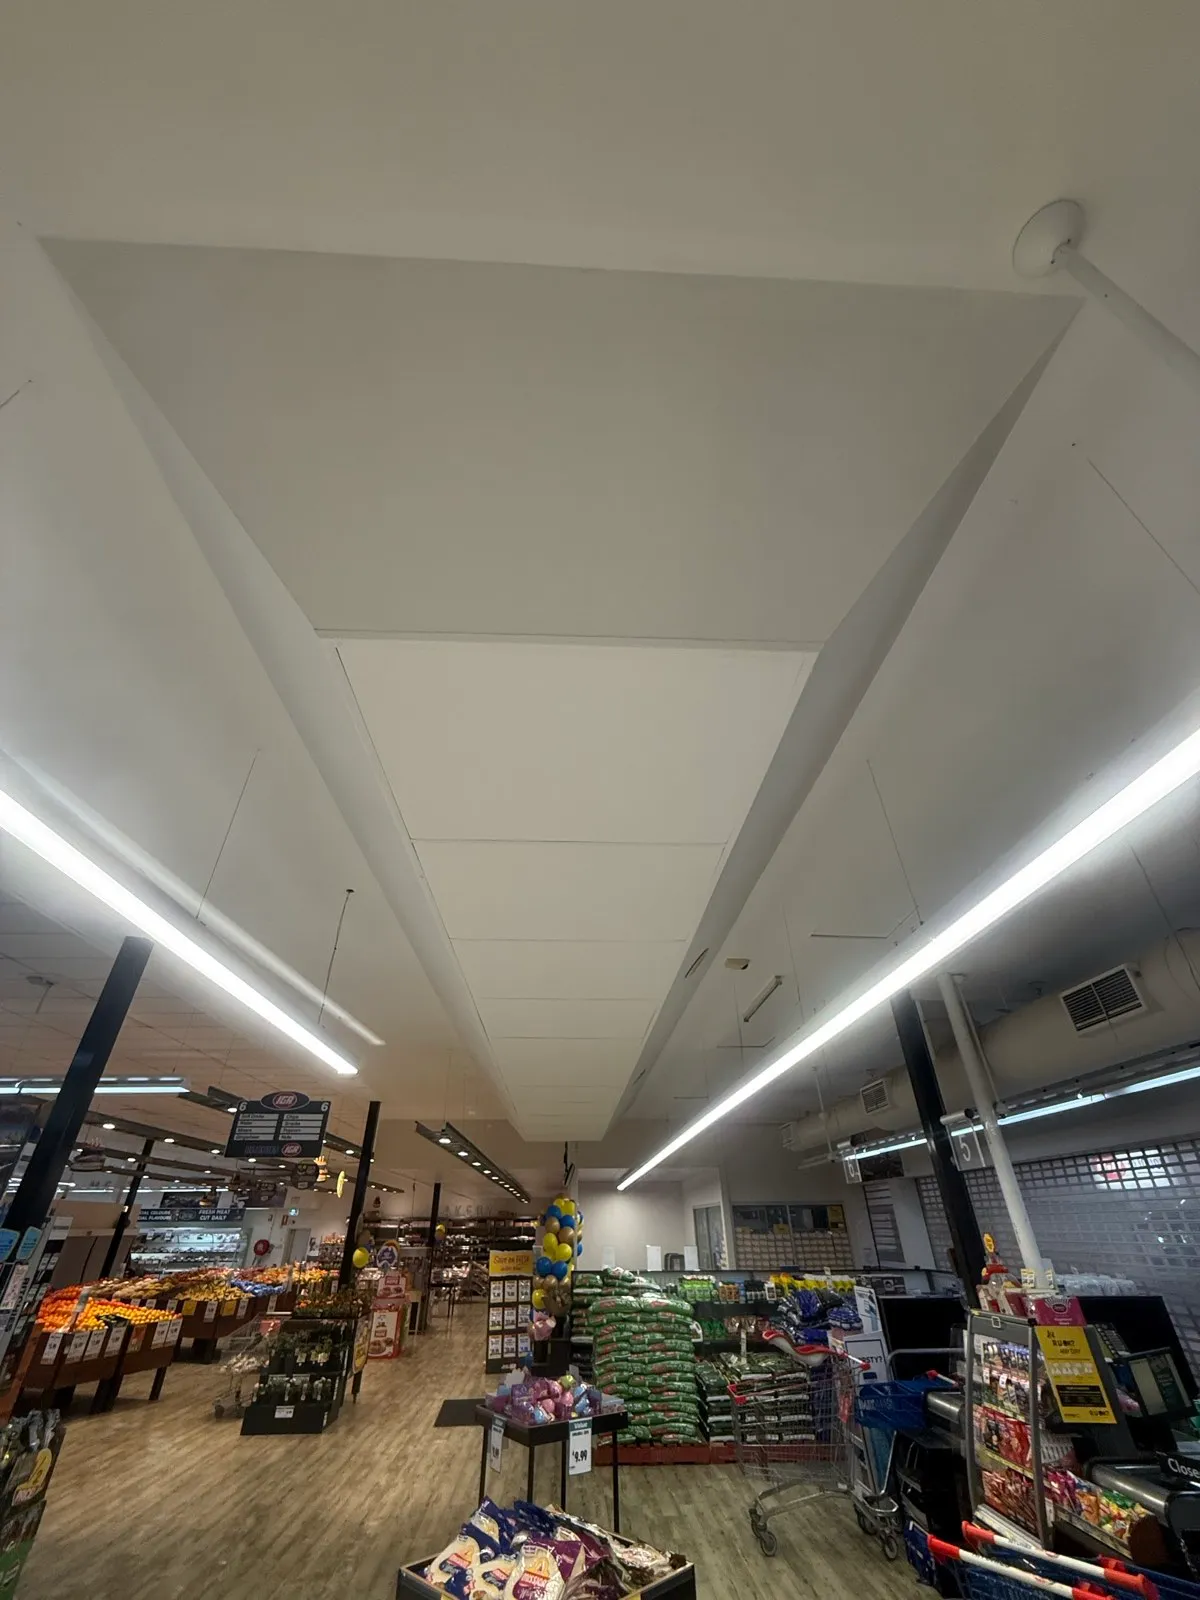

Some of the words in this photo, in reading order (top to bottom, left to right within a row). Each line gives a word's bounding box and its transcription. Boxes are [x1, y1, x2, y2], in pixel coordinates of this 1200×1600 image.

[275, 1095, 295, 1105] IGA
[239, 1102, 248, 1111] 6
[320, 1102, 329, 1112] 6
[284, 1145, 298, 1154] IGA
[958, 1134, 971, 1162] 5
